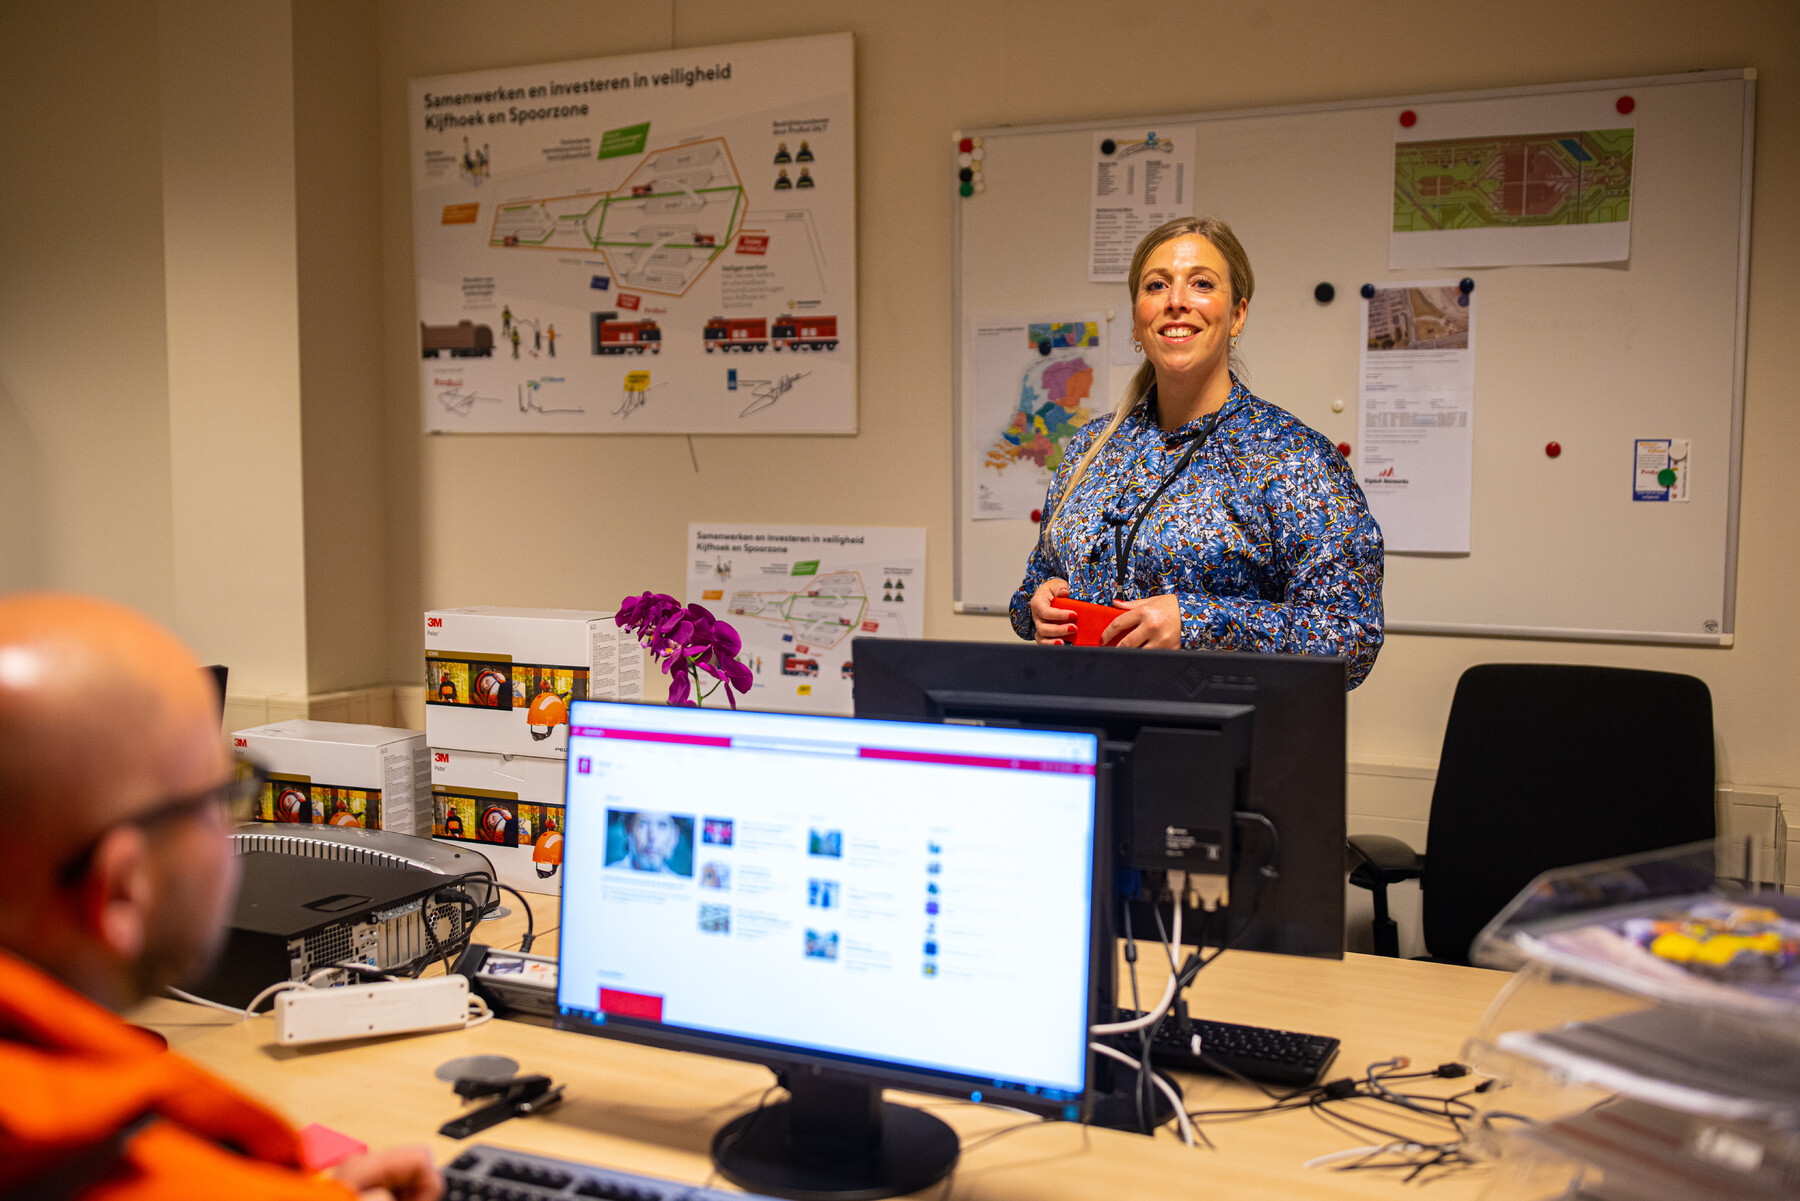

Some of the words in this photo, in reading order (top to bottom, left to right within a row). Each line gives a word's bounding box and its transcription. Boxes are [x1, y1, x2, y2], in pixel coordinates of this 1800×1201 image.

[425, 86, 525, 108] Samenwerken
[528, 83, 547, 98] en
[550, 75, 630, 96] investeren
[633, 72, 649, 88] in
[651, 62, 732, 87] veiligheid
[425, 109, 485, 132] Kijfhoek
[488, 110, 507, 124] en
[509, 102, 590, 126] Spoorzone
[697, 531, 754, 542] Samenwerken
[755, 533, 766, 542] en
[767, 533, 810, 543] investeren
[812, 534, 821, 543] in
[822, 535, 865, 546] veiligheid
[697, 542, 730, 552] Kijfhoek
[732, 544, 742, 552] en
[744, 543, 788, 554] Spoorzone
[427, 617, 442, 628] 3M
[234, 737, 248, 748] 3M
[434, 752, 449, 763] 3M
